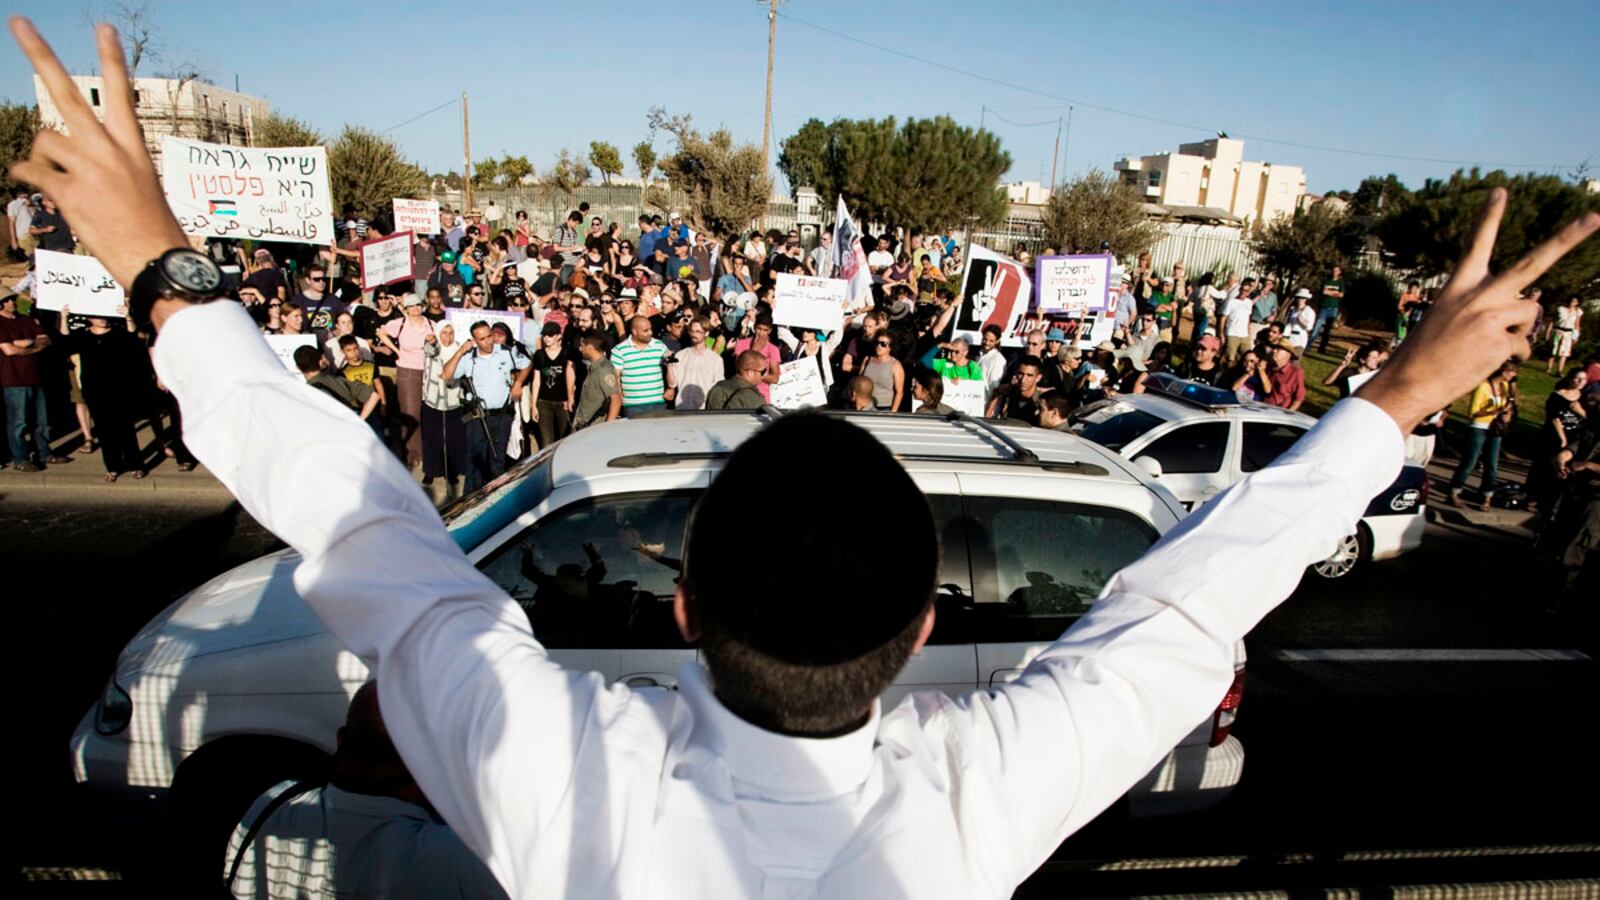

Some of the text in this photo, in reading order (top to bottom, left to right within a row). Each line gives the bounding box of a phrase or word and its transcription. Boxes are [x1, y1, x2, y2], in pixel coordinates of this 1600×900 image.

[189, 170, 314, 199] היא פלסטין
[43, 270, 86, 287] الاحتلال
